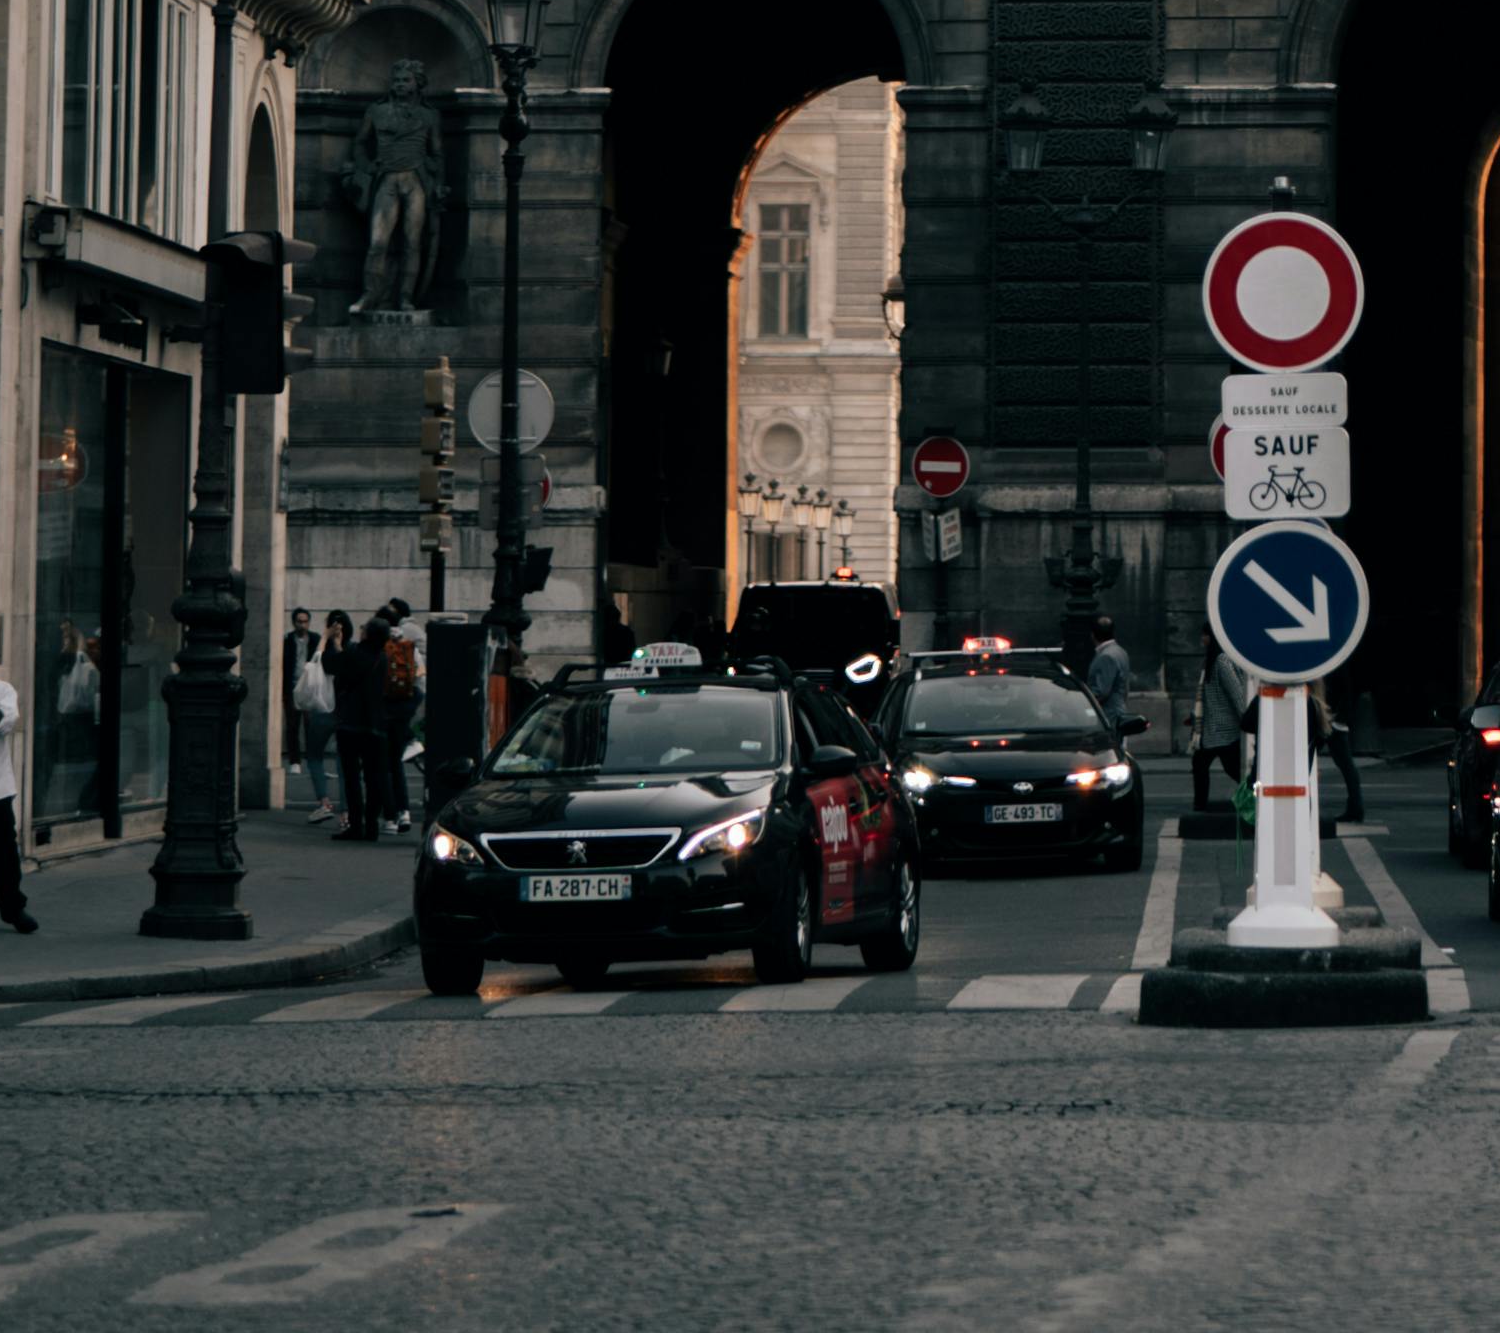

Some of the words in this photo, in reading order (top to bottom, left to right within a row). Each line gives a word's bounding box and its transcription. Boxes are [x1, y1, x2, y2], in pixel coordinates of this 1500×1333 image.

[1270, 386, 1299, 397] SAUF
[1232, 405, 1290, 416] DESSERTE
[1295, 403, 1338, 414] LOCALE
[1254, 434, 1320, 457] SAUF
[650, 645, 680, 657] TAXI
[994, 805, 1055, 821] GE-493-TC
[532, 877, 619, 898] FA-287-CH
